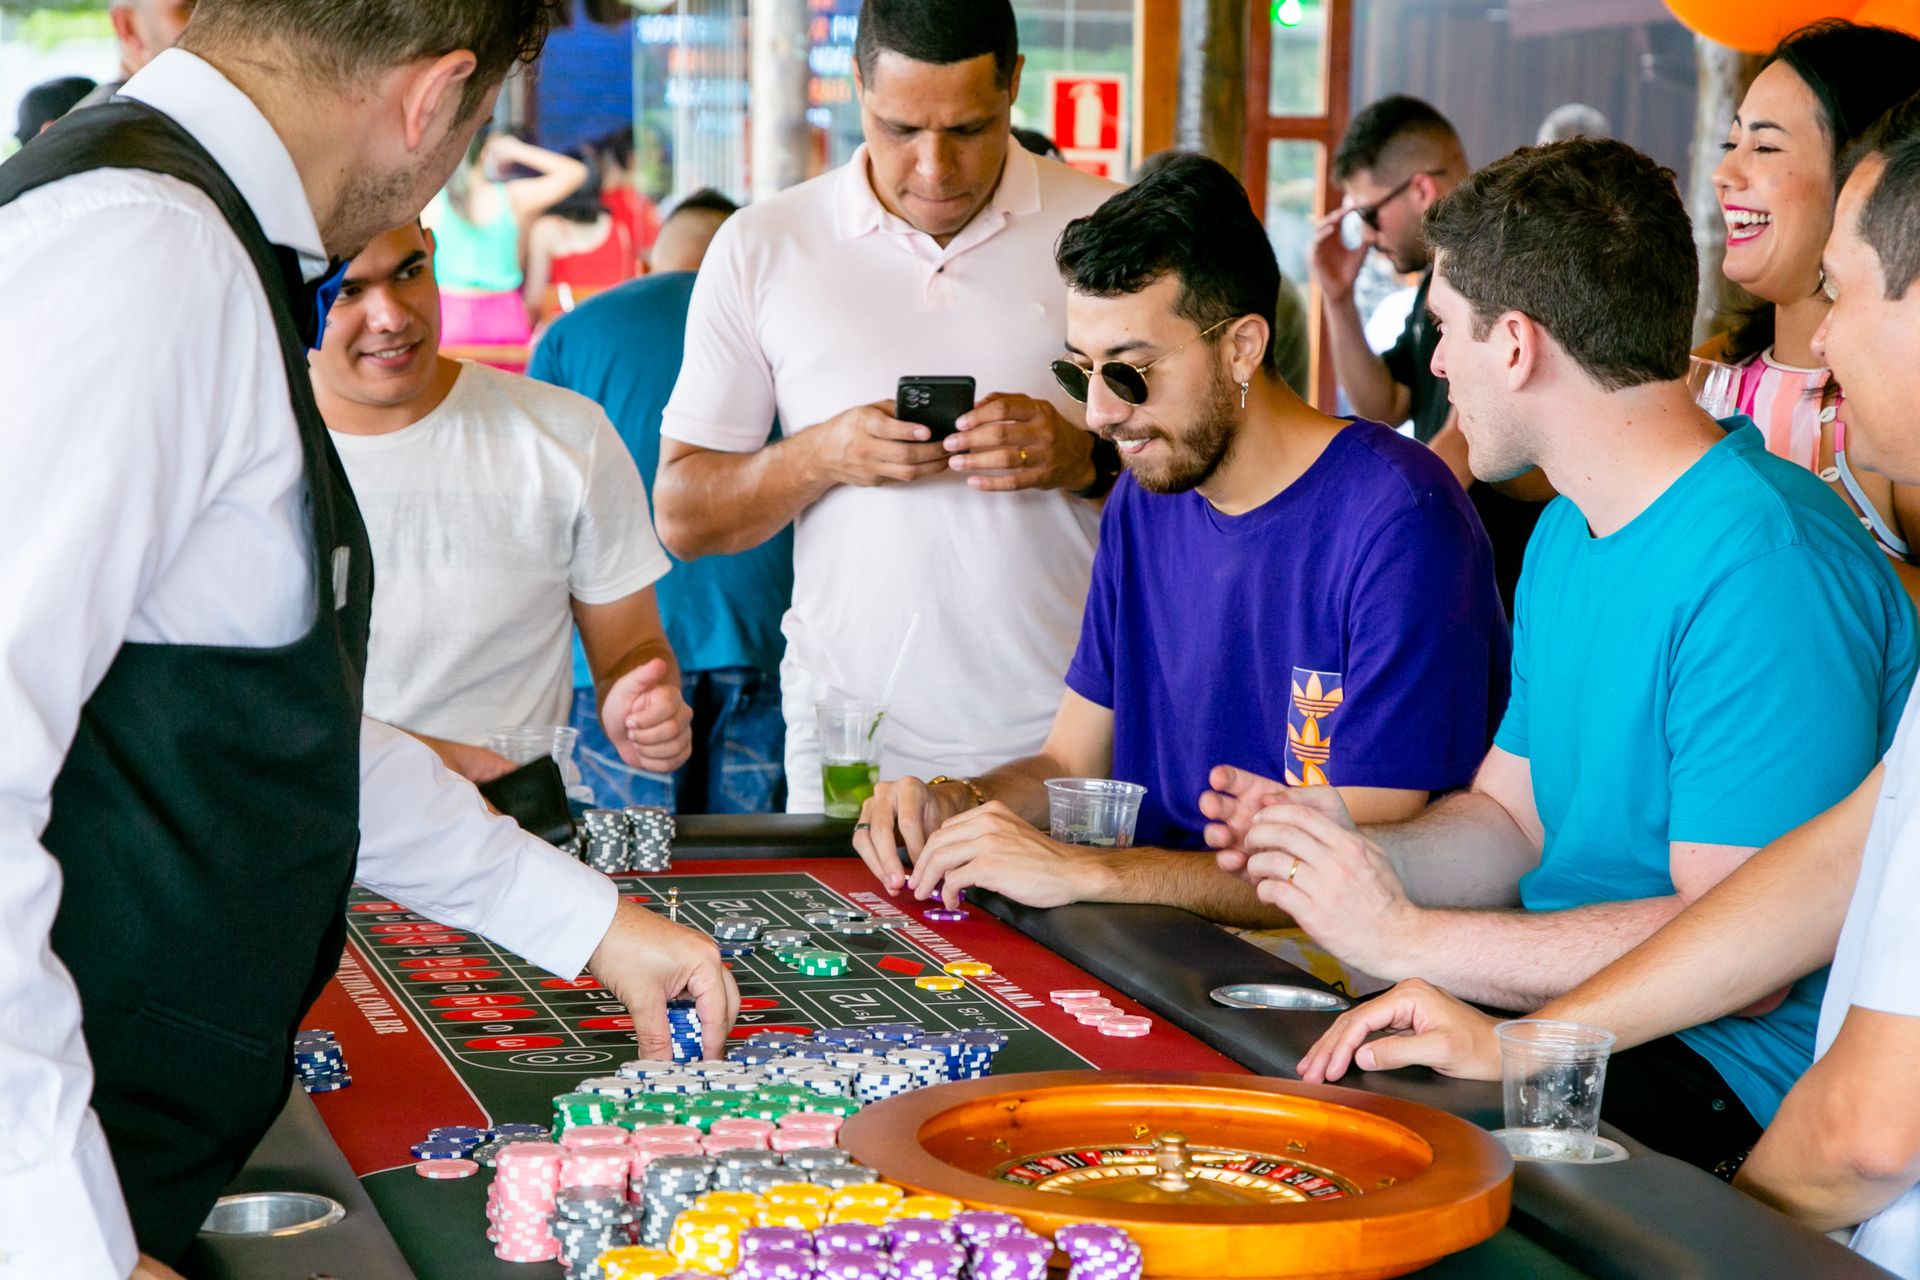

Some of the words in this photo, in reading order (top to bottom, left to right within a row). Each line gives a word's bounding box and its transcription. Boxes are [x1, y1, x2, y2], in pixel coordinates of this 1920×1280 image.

[707, 900, 752, 912] 12
[384, 924, 443, 933] 30
[396, 935, 450, 944] 27
[403, 947, 462, 956] 24
[423, 959, 465, 968] 21
[429, 971, 477, 980] 18
[441, 984, 488, 992] 15
[450, 996, 499, 1005] 12
[829, 993, 881, 1009] 12
[957, 1007, 984, 1016] 18
[495, 1038, 527, 1047] 3
[1251, 1162, 1277, 1174] 15
